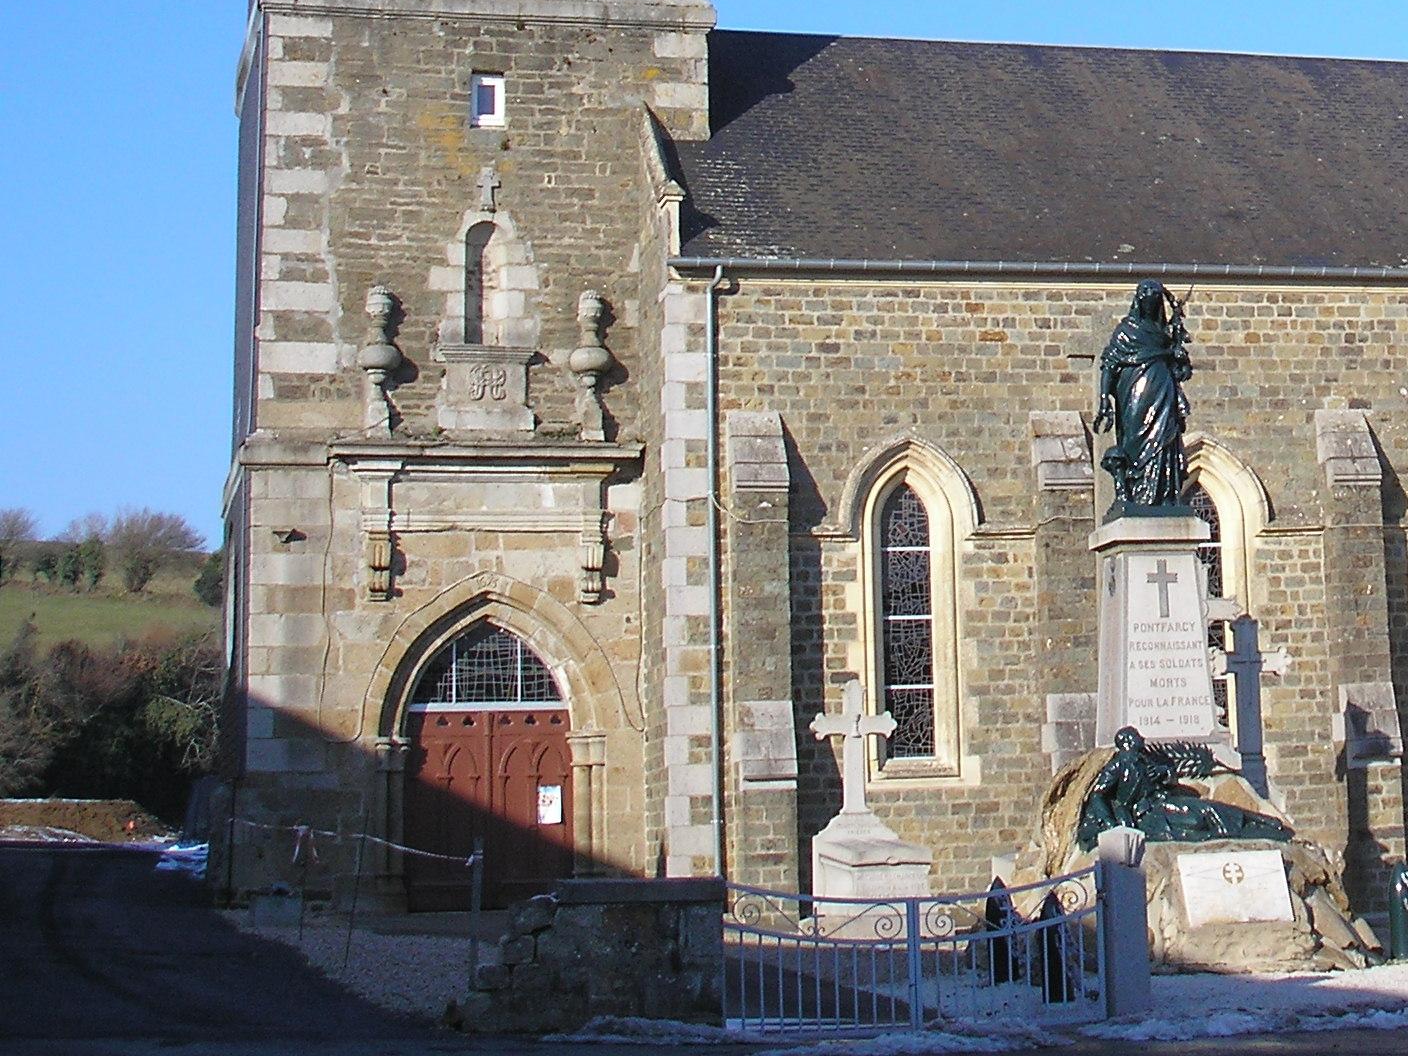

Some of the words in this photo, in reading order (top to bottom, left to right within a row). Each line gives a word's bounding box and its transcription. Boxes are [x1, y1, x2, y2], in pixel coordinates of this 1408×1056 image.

[1133, 622, 1195, 632] PONTFARCY
[1129, 641, 1202, 651] RECONNAISSANT
[1129, 661, 1135, 670] A
[1138, 660, 1155, 670] SES
[1159, 658, 1203, 669] SOLDATS
[1150, 678, 1187, 687] MORTS
[1129, 697, 1153, 708] POUR
[1156, 697, 1168, 707] LA
[1171, 696, 1210, 705] FRANCE
[1139, 715, 1161, 726] 1914
[1179, 715, 1200, 725] 1918
